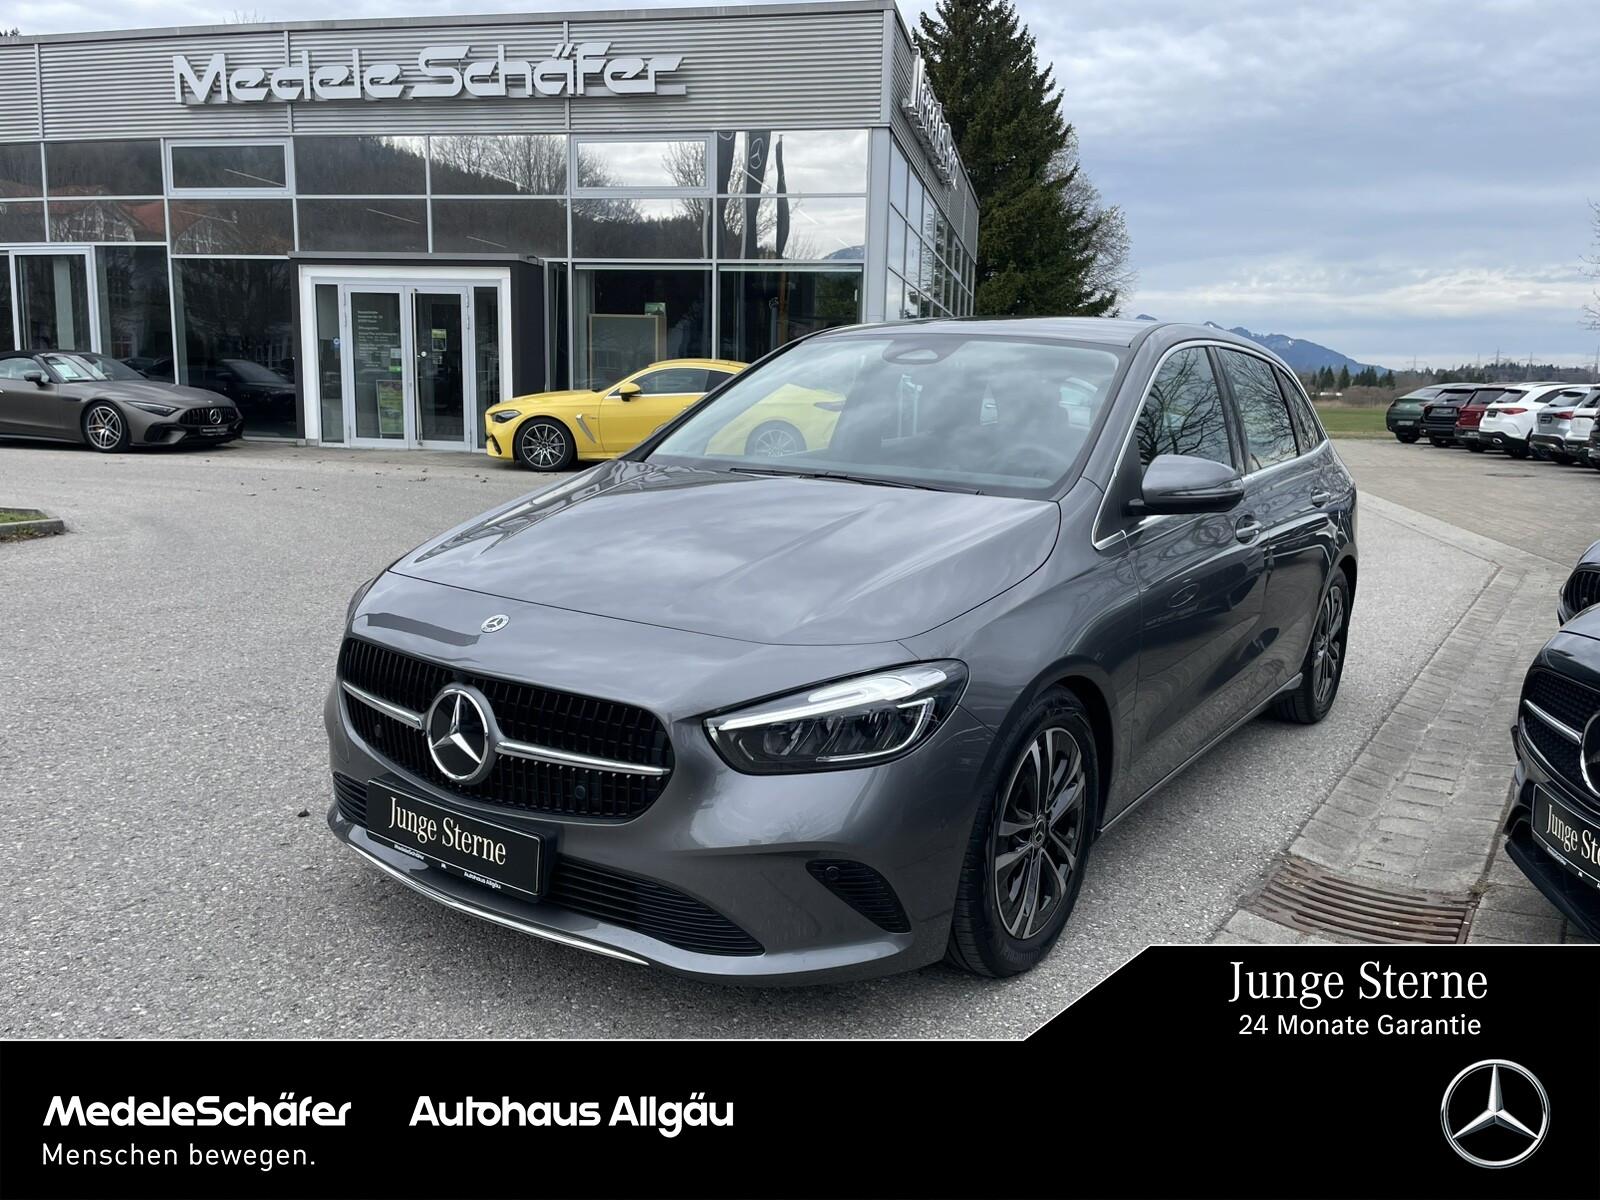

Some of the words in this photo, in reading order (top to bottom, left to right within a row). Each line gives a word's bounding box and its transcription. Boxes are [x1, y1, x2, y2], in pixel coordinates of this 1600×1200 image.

[388, 797, 437, 844] Junge
[442, 817, 506, 866] Sterne
[1545, 803, 1578, 853] Junge
